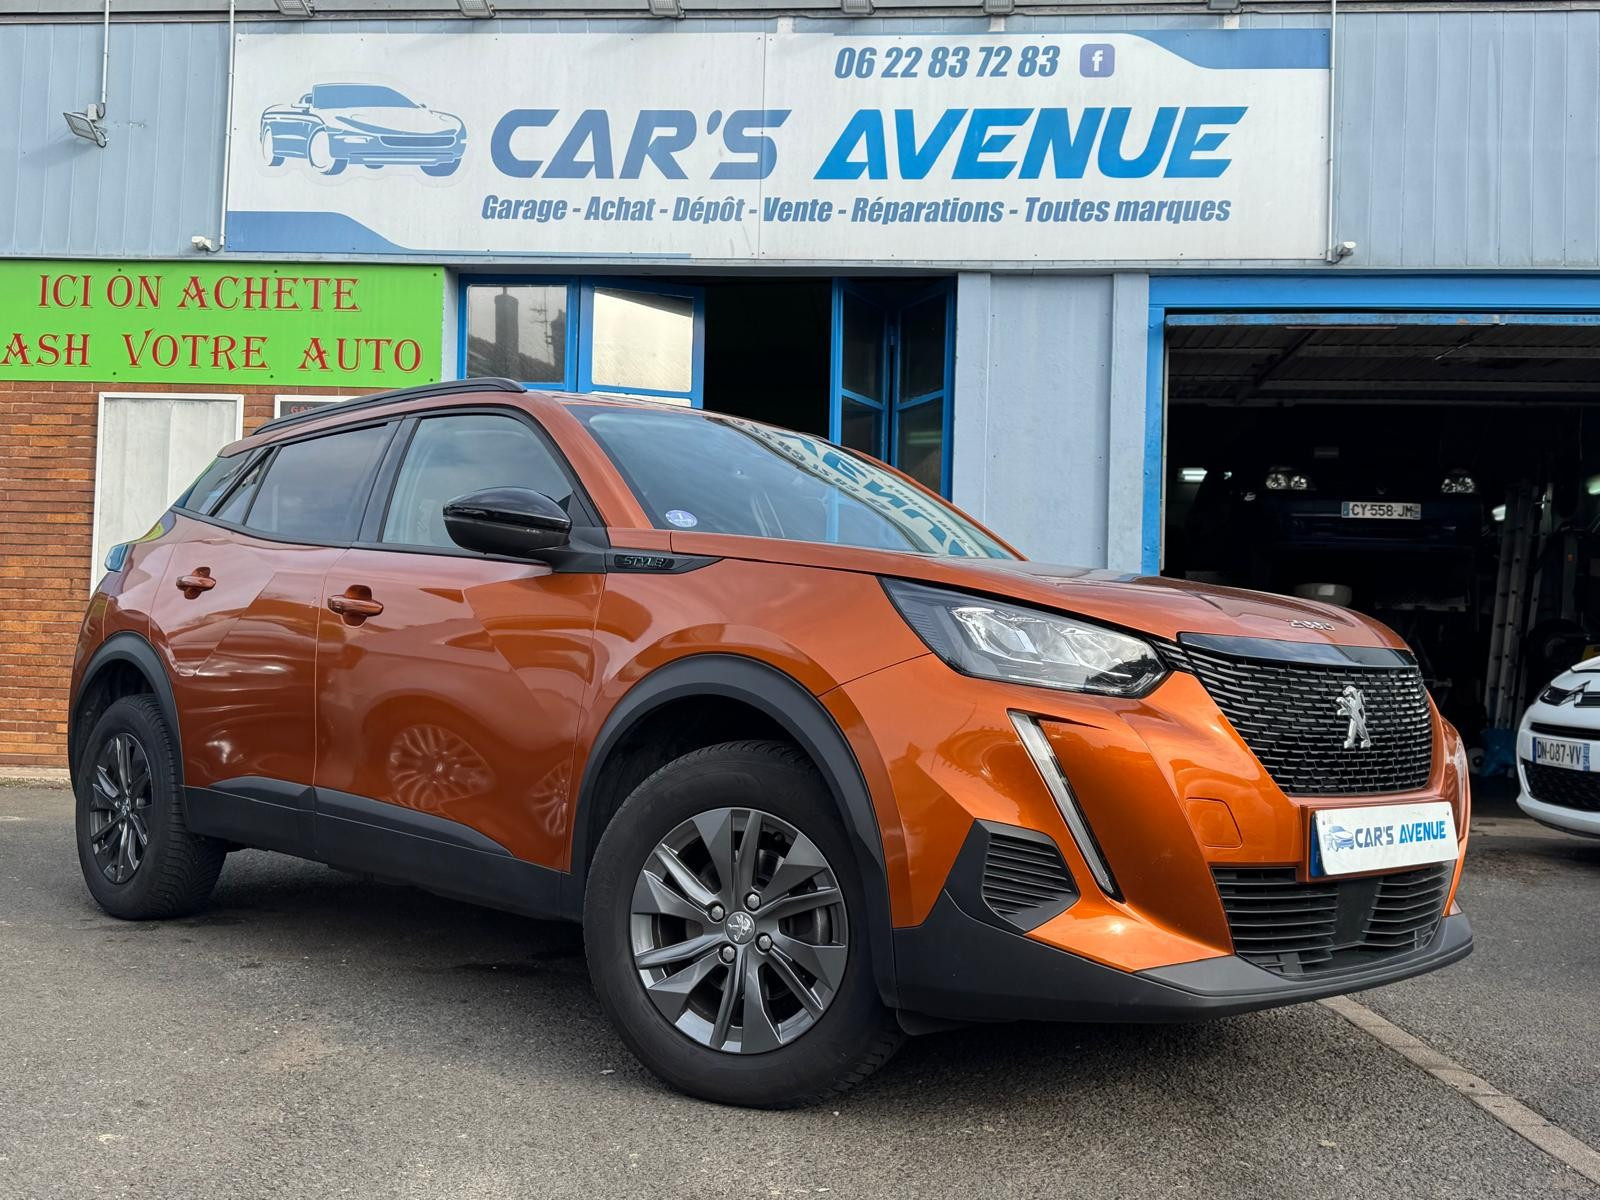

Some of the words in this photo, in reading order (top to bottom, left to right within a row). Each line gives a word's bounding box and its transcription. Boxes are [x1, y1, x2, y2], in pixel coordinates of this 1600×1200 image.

[834, 46, 876, 79] 06
[881, 46, 924, 78] 22
[927, 46, 972, 78] 83
[976, 45, 1013, 78] 72
[1017, 45, 1060, 78] 83
[490, 108, 792, 180] CAR'S
[812, 105, 1249, 181] AVENUE
[482, 195, 568, 223] Garage
[585, 196, 656, 221] Achat
[672, 196, 745, 224] Dépôt
[763, 196, 834, 222] Vente
[851, 196, 1005, 225] Réparations
[1025, 196, 1110, 223] Toutes
[1114, 199, 1231, 225] marques
[38, 274, 94, 309] ICI
[106, 275, 163, 310] ON
[177, 275, 361, 312] ACHETE
[121, 328, 270, 371] VOTRE
[297, 336, 423, 373] AUTO
[623, 556, 666, 568] STYLE
[1354, 825, 1394, 849] CAR'S
[1399, 820, 1447, 844] AVENUE
